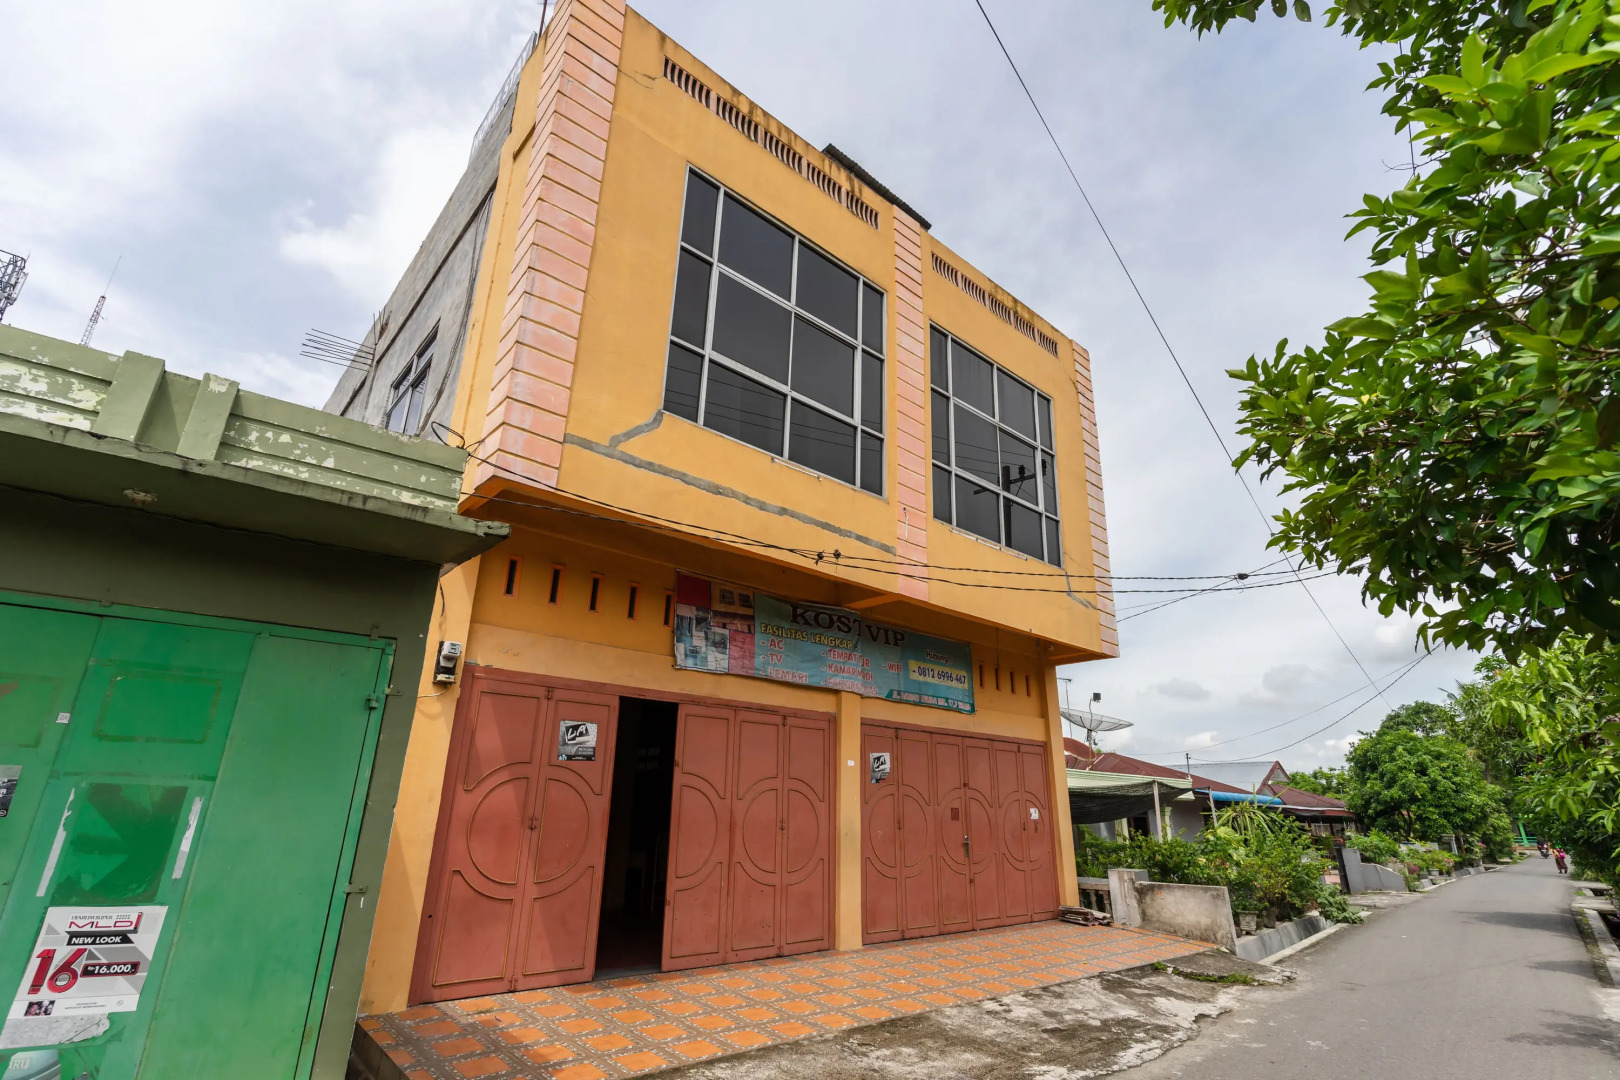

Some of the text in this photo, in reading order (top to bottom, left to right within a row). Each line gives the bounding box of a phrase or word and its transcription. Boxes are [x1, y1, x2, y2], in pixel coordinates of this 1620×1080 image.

[761, 623, 808, 641] FASILITAS
[811, 633, 853, 650] LENGKAP
[865, 624, 905, 647] VIP
[768, 637, 784, 650] AC
[768, 652, 784, 665] TV
[828, 649, 858, 664] TEMPAT
[827, 663, 856, 677] KAMAR
[887, 662, 902, 673] WIFI
[918, 665, 967, 685] 0812 6996 467
[768, 667, 808, 684] LEMARI
[567, 725, 586, 740] LA
[27, 948, 88, 994] 16
